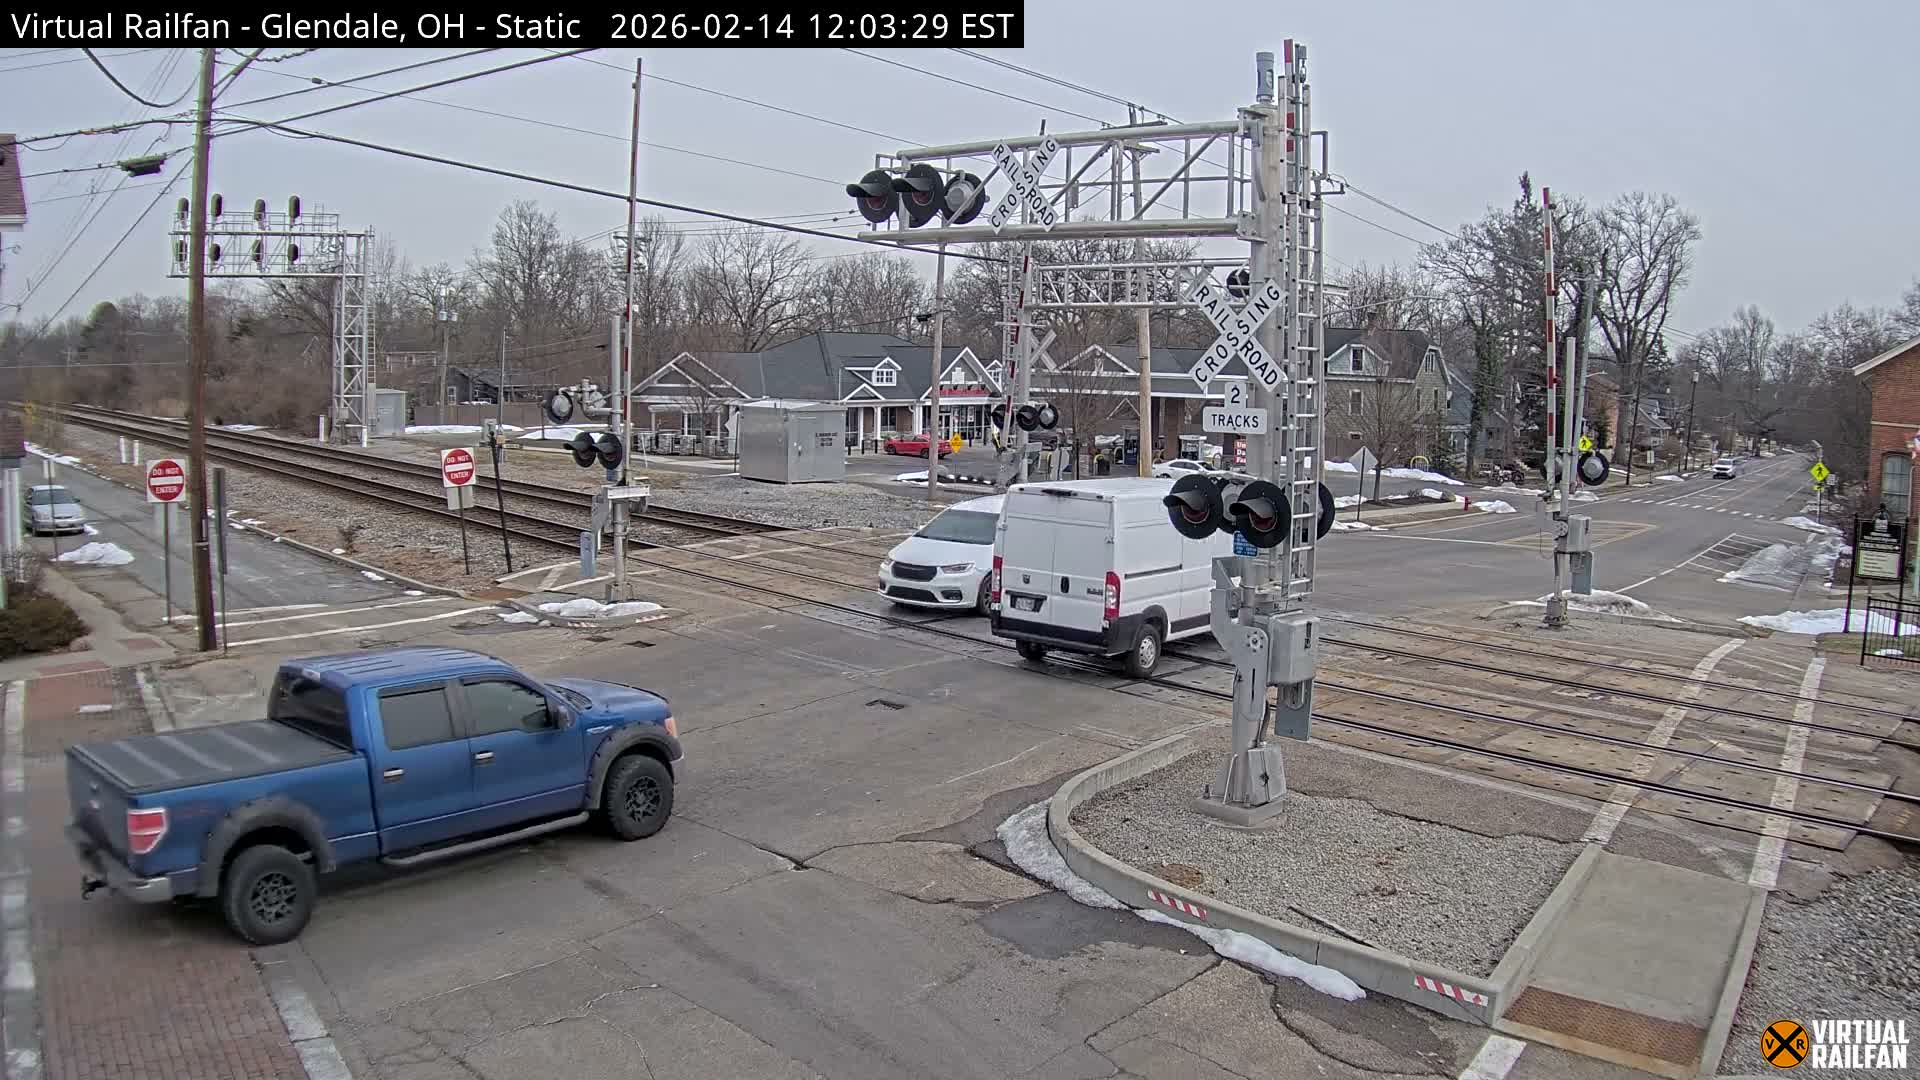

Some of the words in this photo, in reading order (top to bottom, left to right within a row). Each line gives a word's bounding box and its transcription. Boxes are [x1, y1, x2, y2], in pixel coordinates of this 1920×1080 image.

[991, 140, 1056, 228] CROSSING
[1195, 285, 1280, 383] CROSSING
[1230, 386, 1241, 404] 2
[1211, 414, 1259, 429] TRACKS
[457, 454, 469, 462] NOT
[152, 468, 161, 476] DO
[450, 471, 469, 480] ENTER
[155, 485, 177, 494] ENTER
